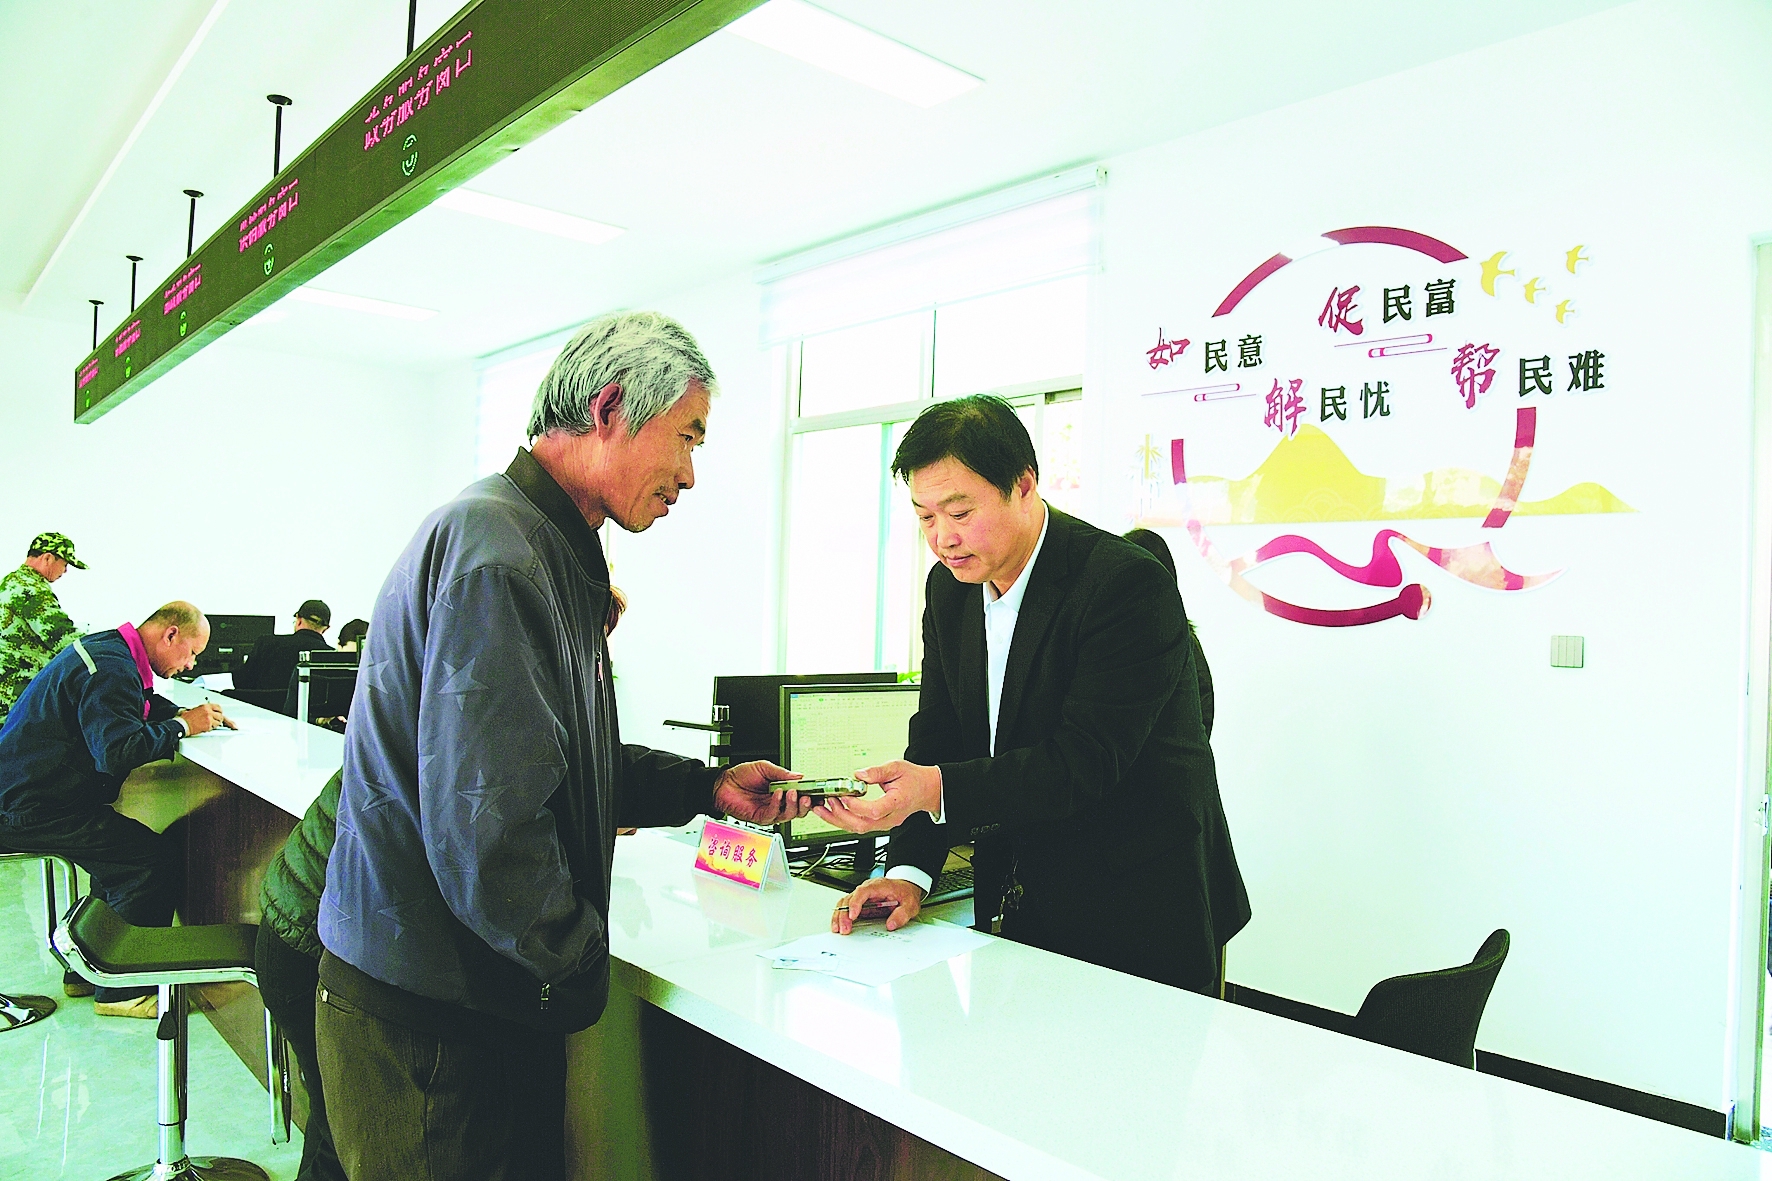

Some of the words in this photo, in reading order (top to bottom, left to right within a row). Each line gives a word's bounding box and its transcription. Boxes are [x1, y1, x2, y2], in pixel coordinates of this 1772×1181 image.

[1319, 278, 1457, 335] 促民富
[1146, 327, 1263, 374] 如民意
[1451, 340, 1605, 410] 帮民难
[1264, 377, 1391, 437] 解民忧
[708, 834, 758, 867] 咨询服务
